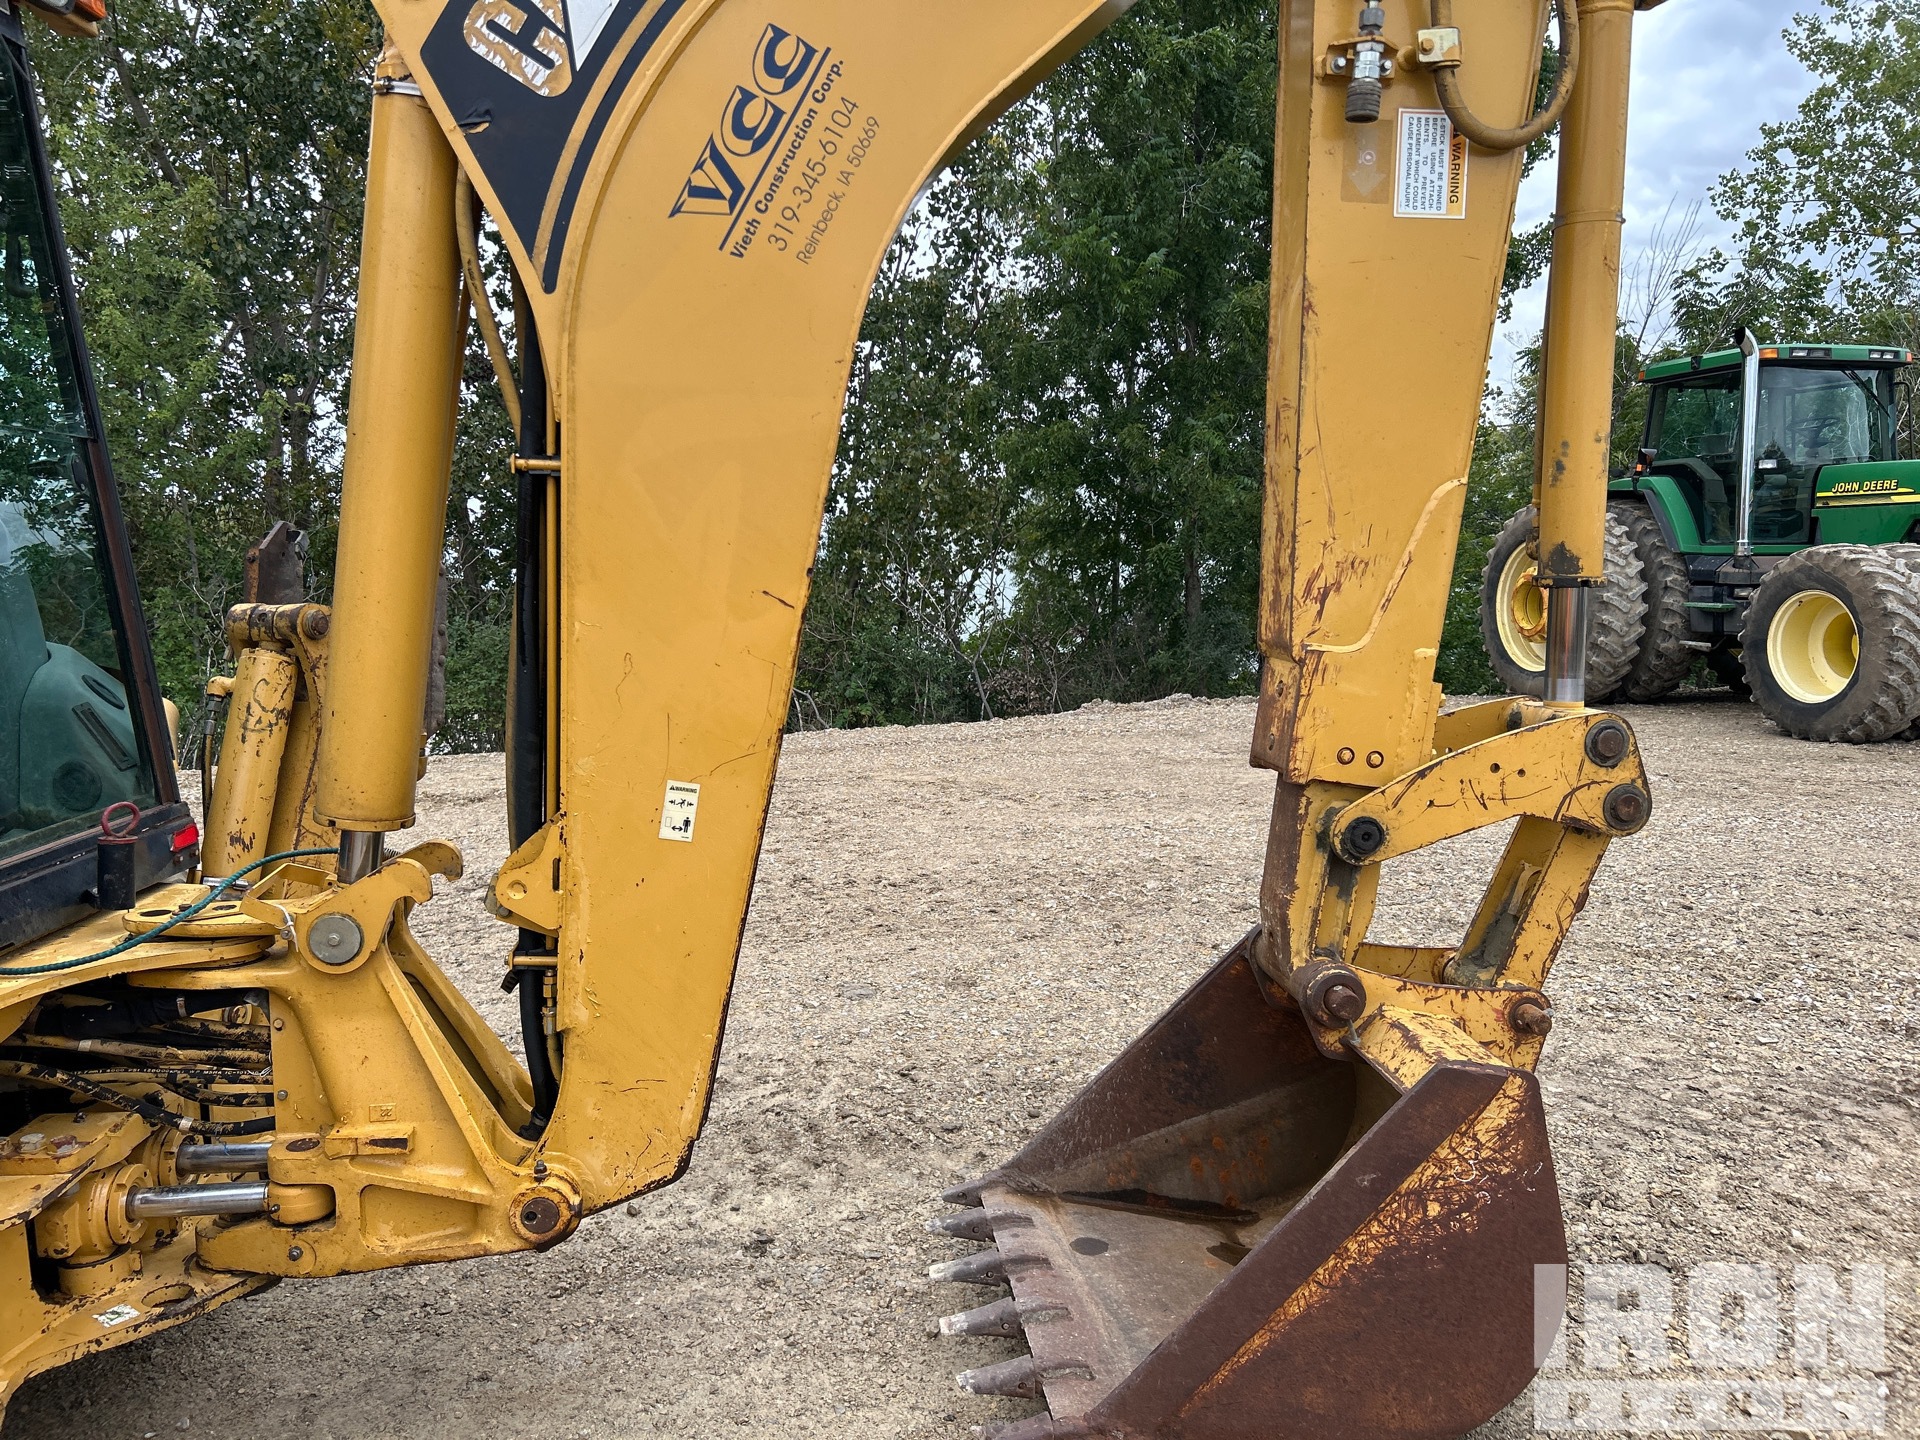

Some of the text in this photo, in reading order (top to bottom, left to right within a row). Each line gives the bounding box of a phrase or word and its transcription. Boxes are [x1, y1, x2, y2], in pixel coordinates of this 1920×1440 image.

[669, 23, 819, 219] VCC
[730, 59, 844, 260] Vieth Construction Corp.
[1422, 156, 1428, 165] TO
[1449, 142, 1462, 203] WARNING
[767, 96, 859, 252] 319-345-6104
[797, 116, 880, 266] Reinbeck, IA 50669
[1437, 172, 1443, 182] BE
[1832, 480, 1898, 493] JOHN DEERE
